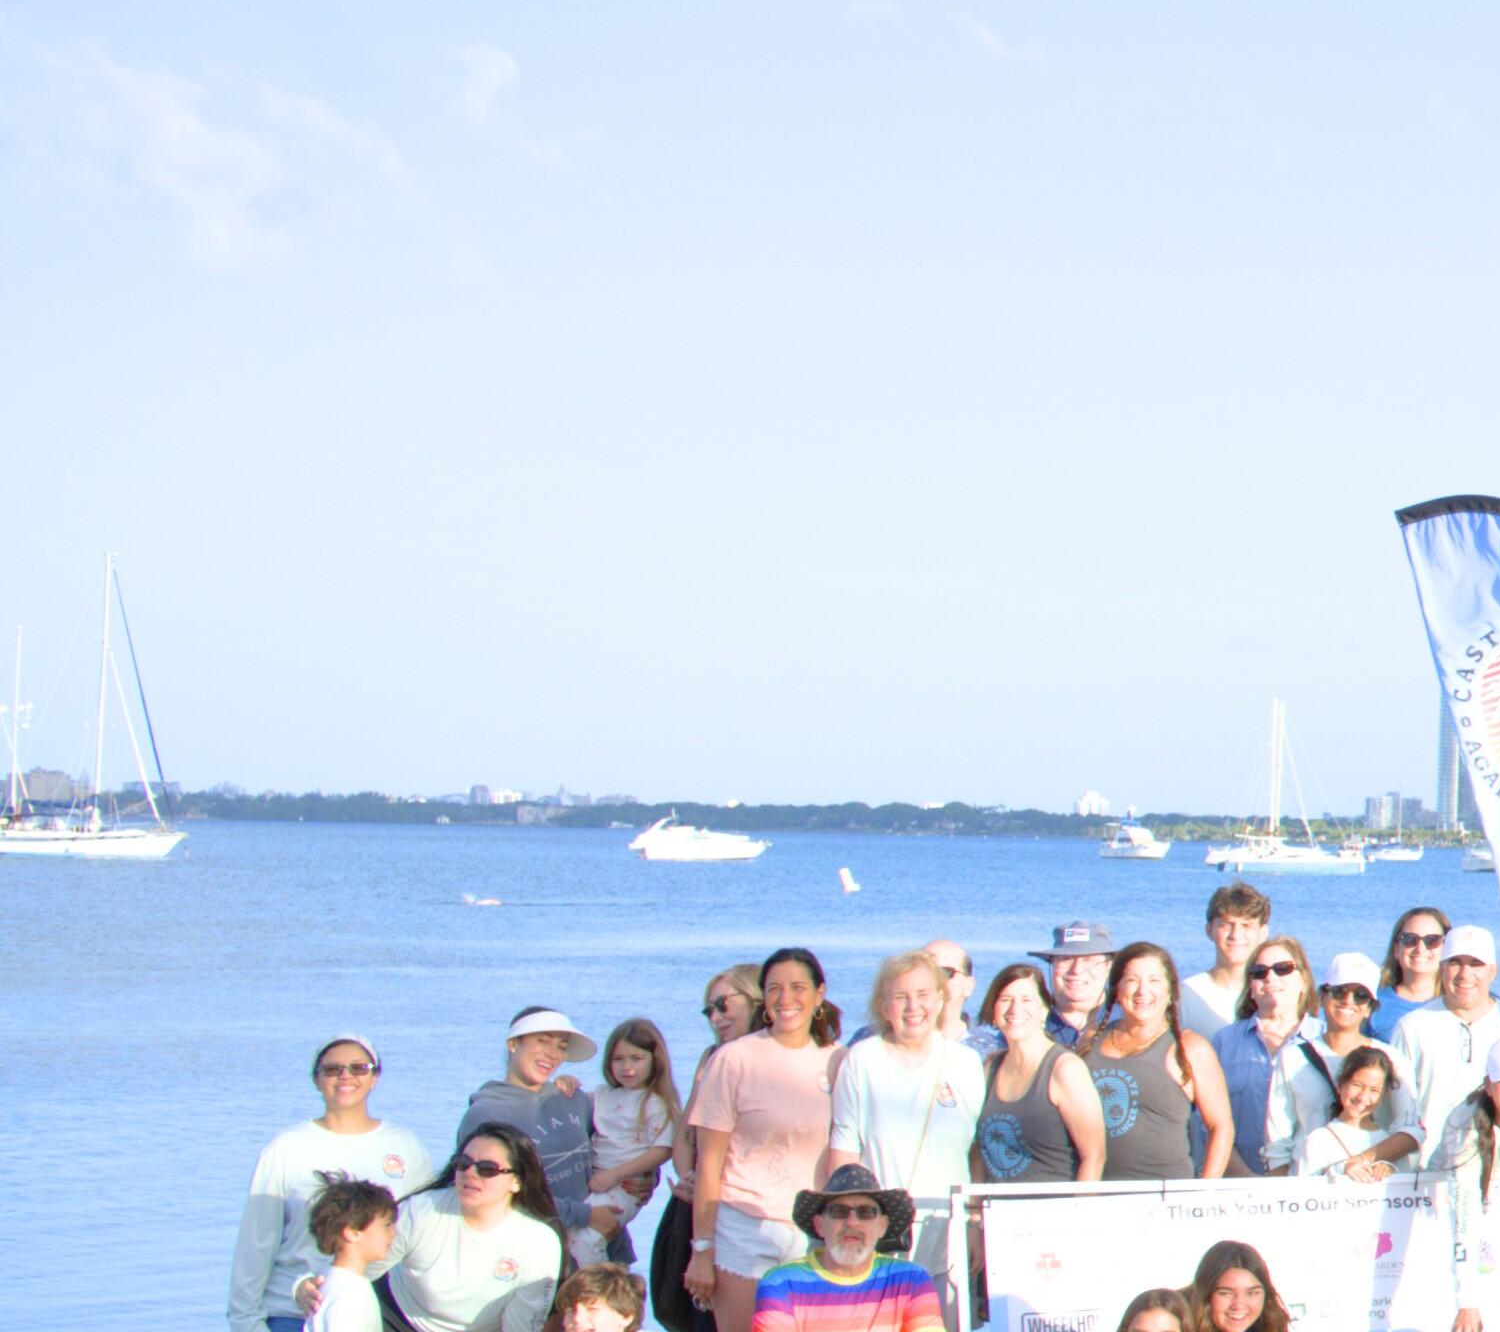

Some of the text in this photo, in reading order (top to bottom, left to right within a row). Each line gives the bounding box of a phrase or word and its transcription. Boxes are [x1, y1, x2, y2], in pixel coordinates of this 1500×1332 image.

[1093, 1068, 1140, 1095] STAWAYS
[1167, 1203, 1229, 1219] Thank
[1277, 1199, 1299, 1214] To
[1304, 1197, 1340, 1213] Our
